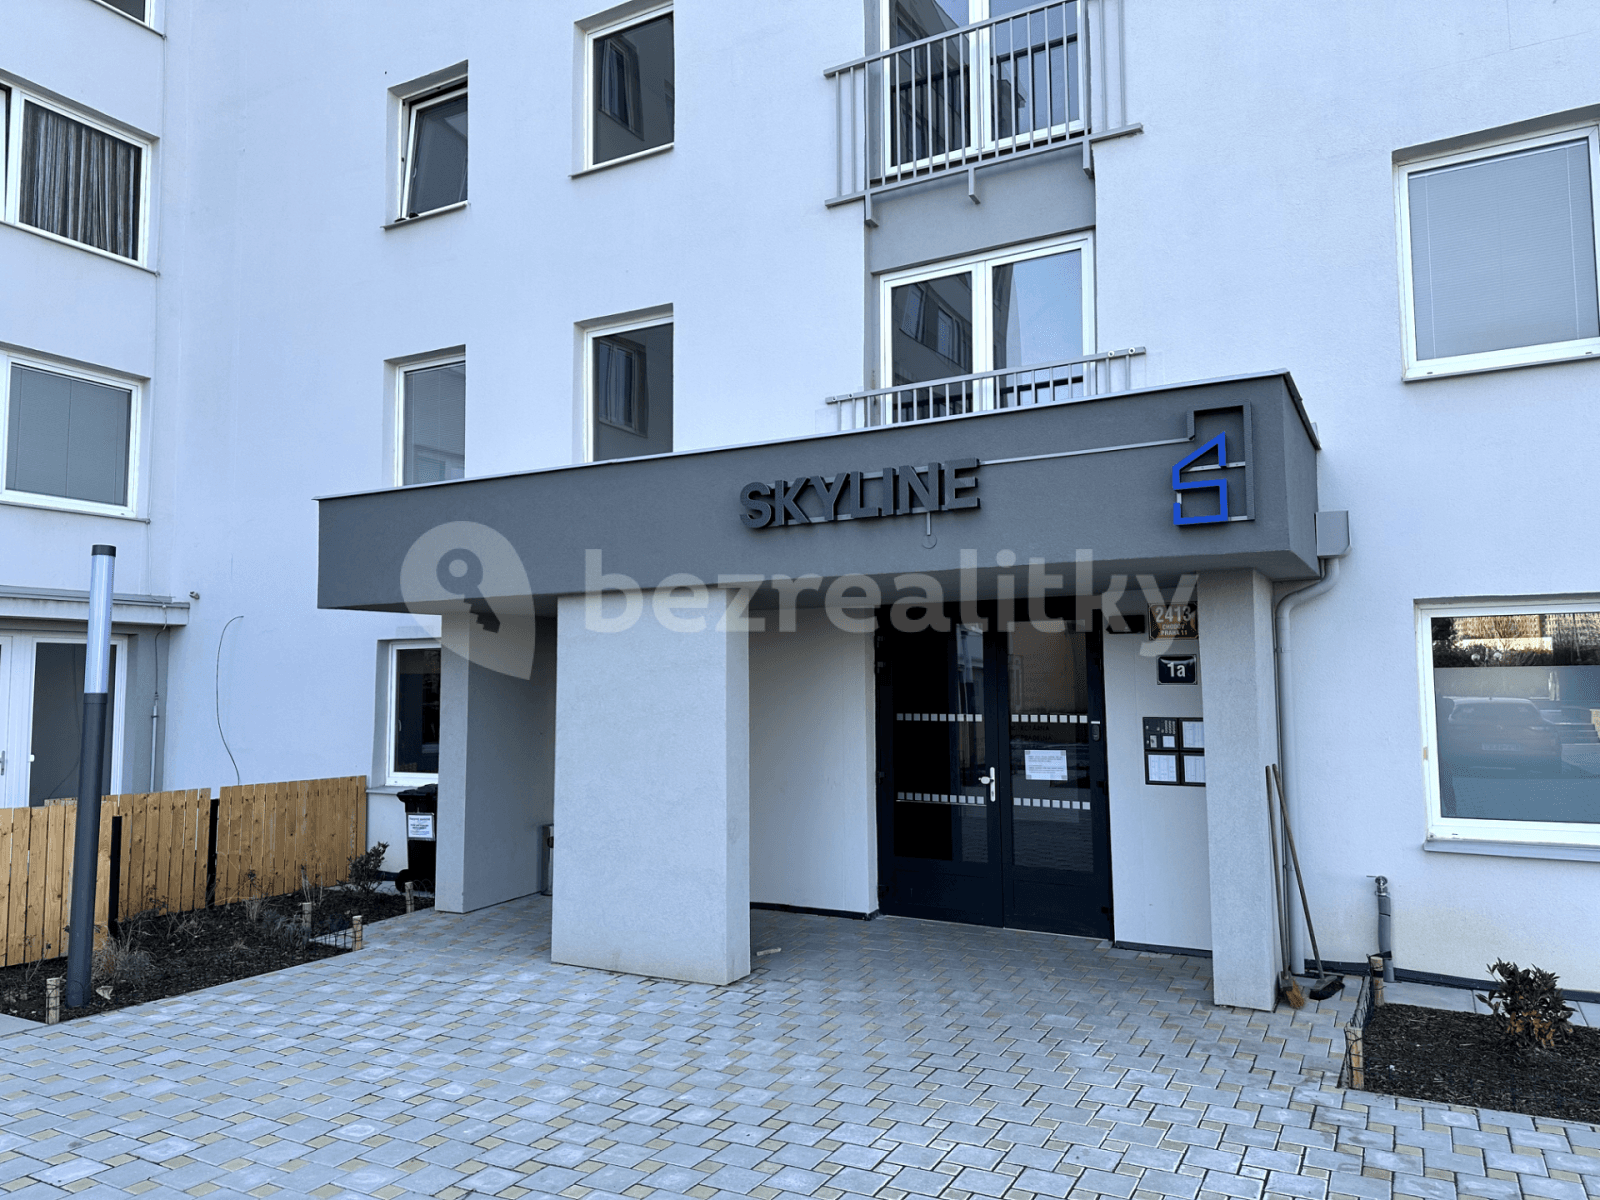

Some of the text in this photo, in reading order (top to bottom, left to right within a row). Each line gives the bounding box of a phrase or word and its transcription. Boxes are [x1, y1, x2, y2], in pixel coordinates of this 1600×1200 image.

[739, 457, 981, 529] SKYLINE
[1155, 605, 1192, 623] 2413
[1167, 662, 1186, 678] 1a
